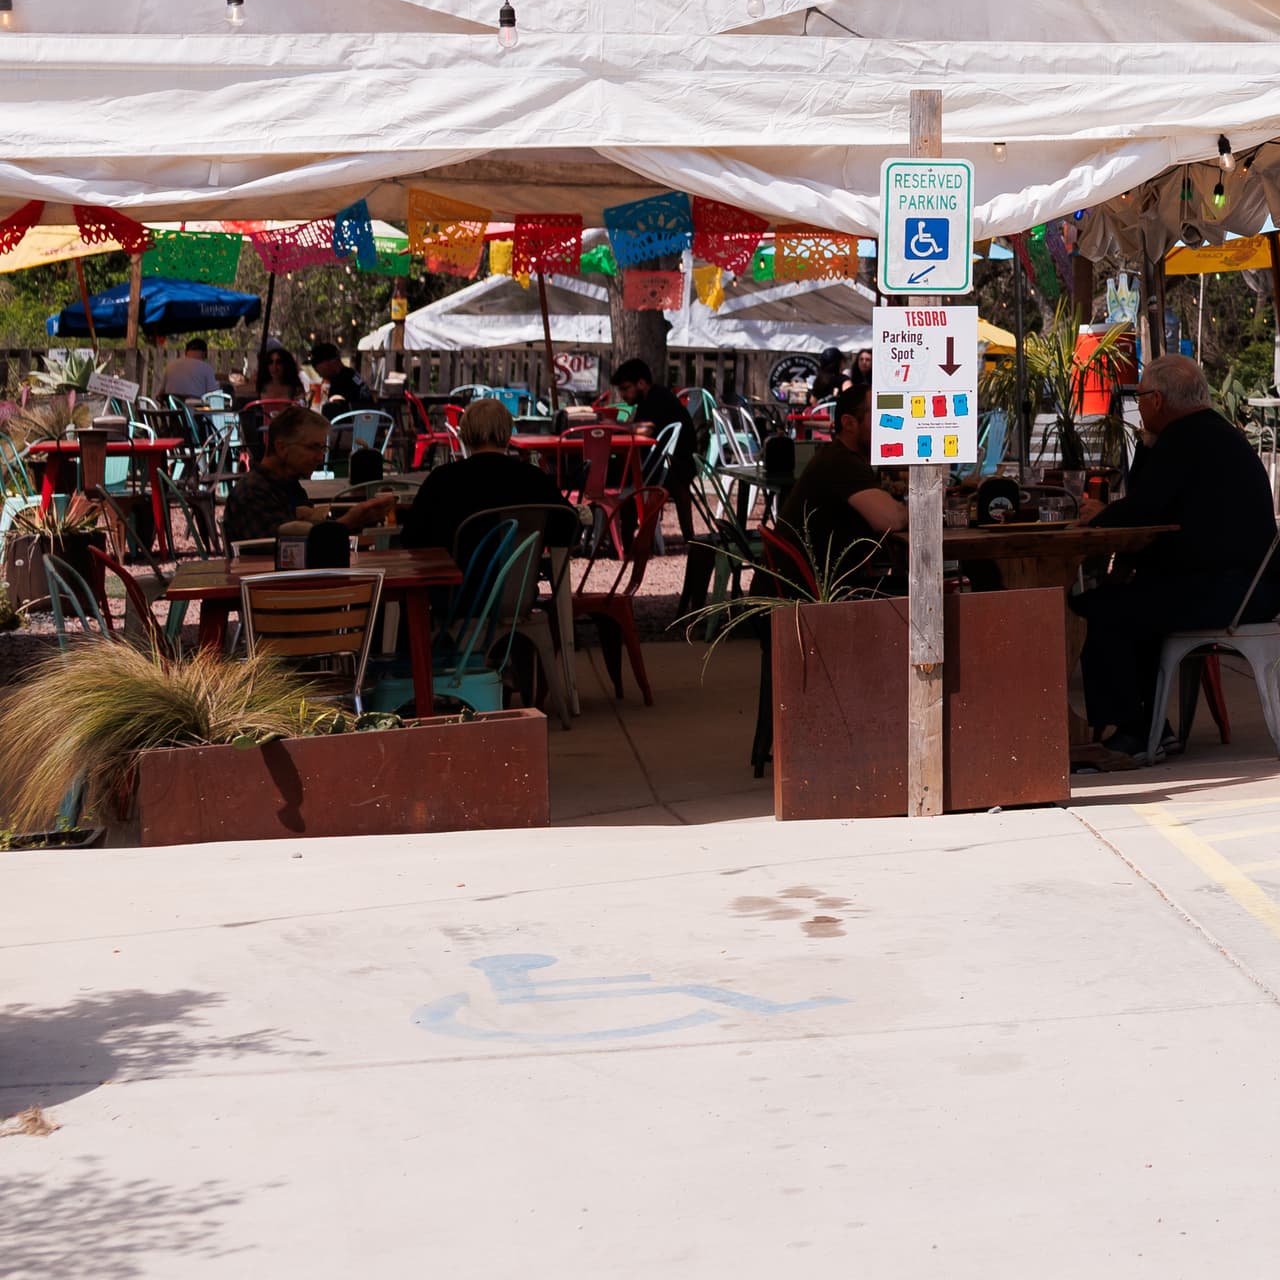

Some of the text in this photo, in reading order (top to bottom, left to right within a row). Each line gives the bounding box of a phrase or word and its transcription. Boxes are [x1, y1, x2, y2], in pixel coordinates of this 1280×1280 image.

[894, 172, 963, 190] RESERVED
[898, 194, 957, 211] PARKING
[904, 310, 948, 328] TESORO
[882, 330, 923, 348] Parking
[890, 347, 915, 363] Spot
[894, 364, 911, 384] #7
